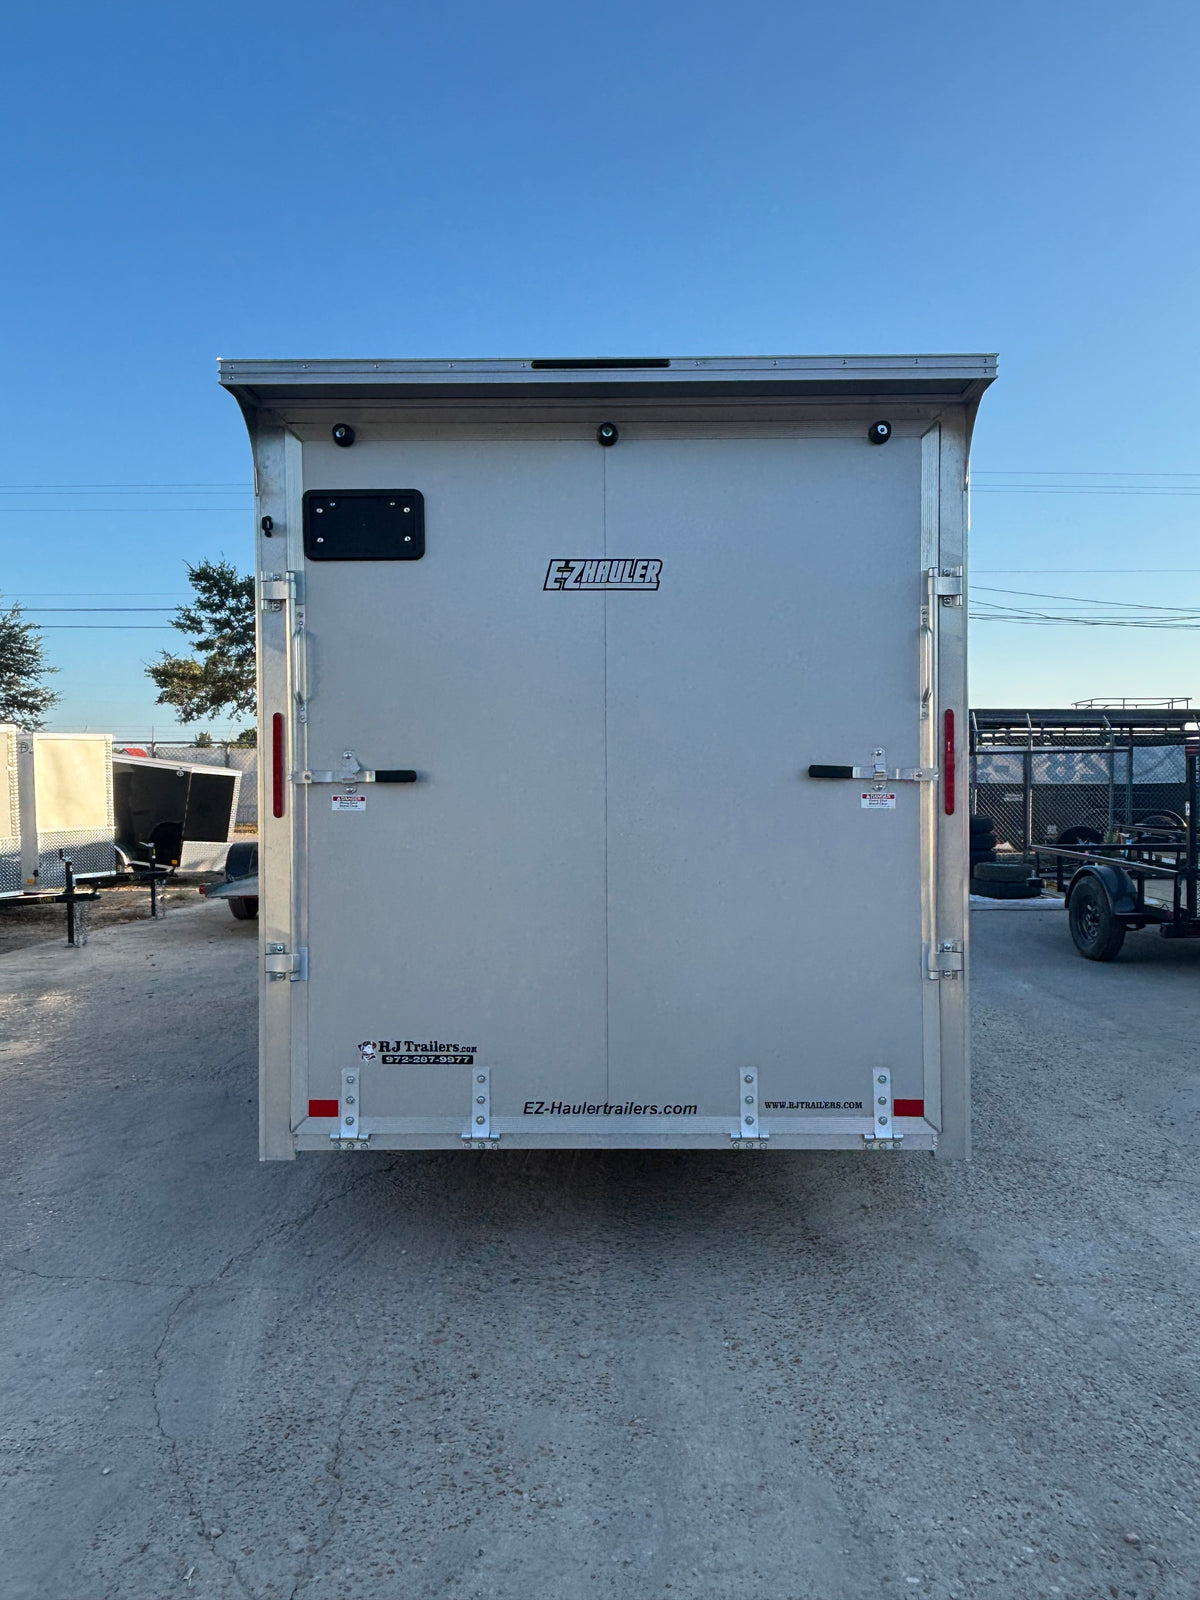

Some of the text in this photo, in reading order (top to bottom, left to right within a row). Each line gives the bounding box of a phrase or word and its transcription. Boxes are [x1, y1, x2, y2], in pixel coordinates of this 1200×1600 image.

[378, 1040, 402, 1053] RJ
[385, 1056, 470, 1064] 972-287-9977
[523, 1101, 698, 1115] EZ-Haulertrailers.com
[764, 1101, 863, 1109] WWW.RJTRAILERS.COM
